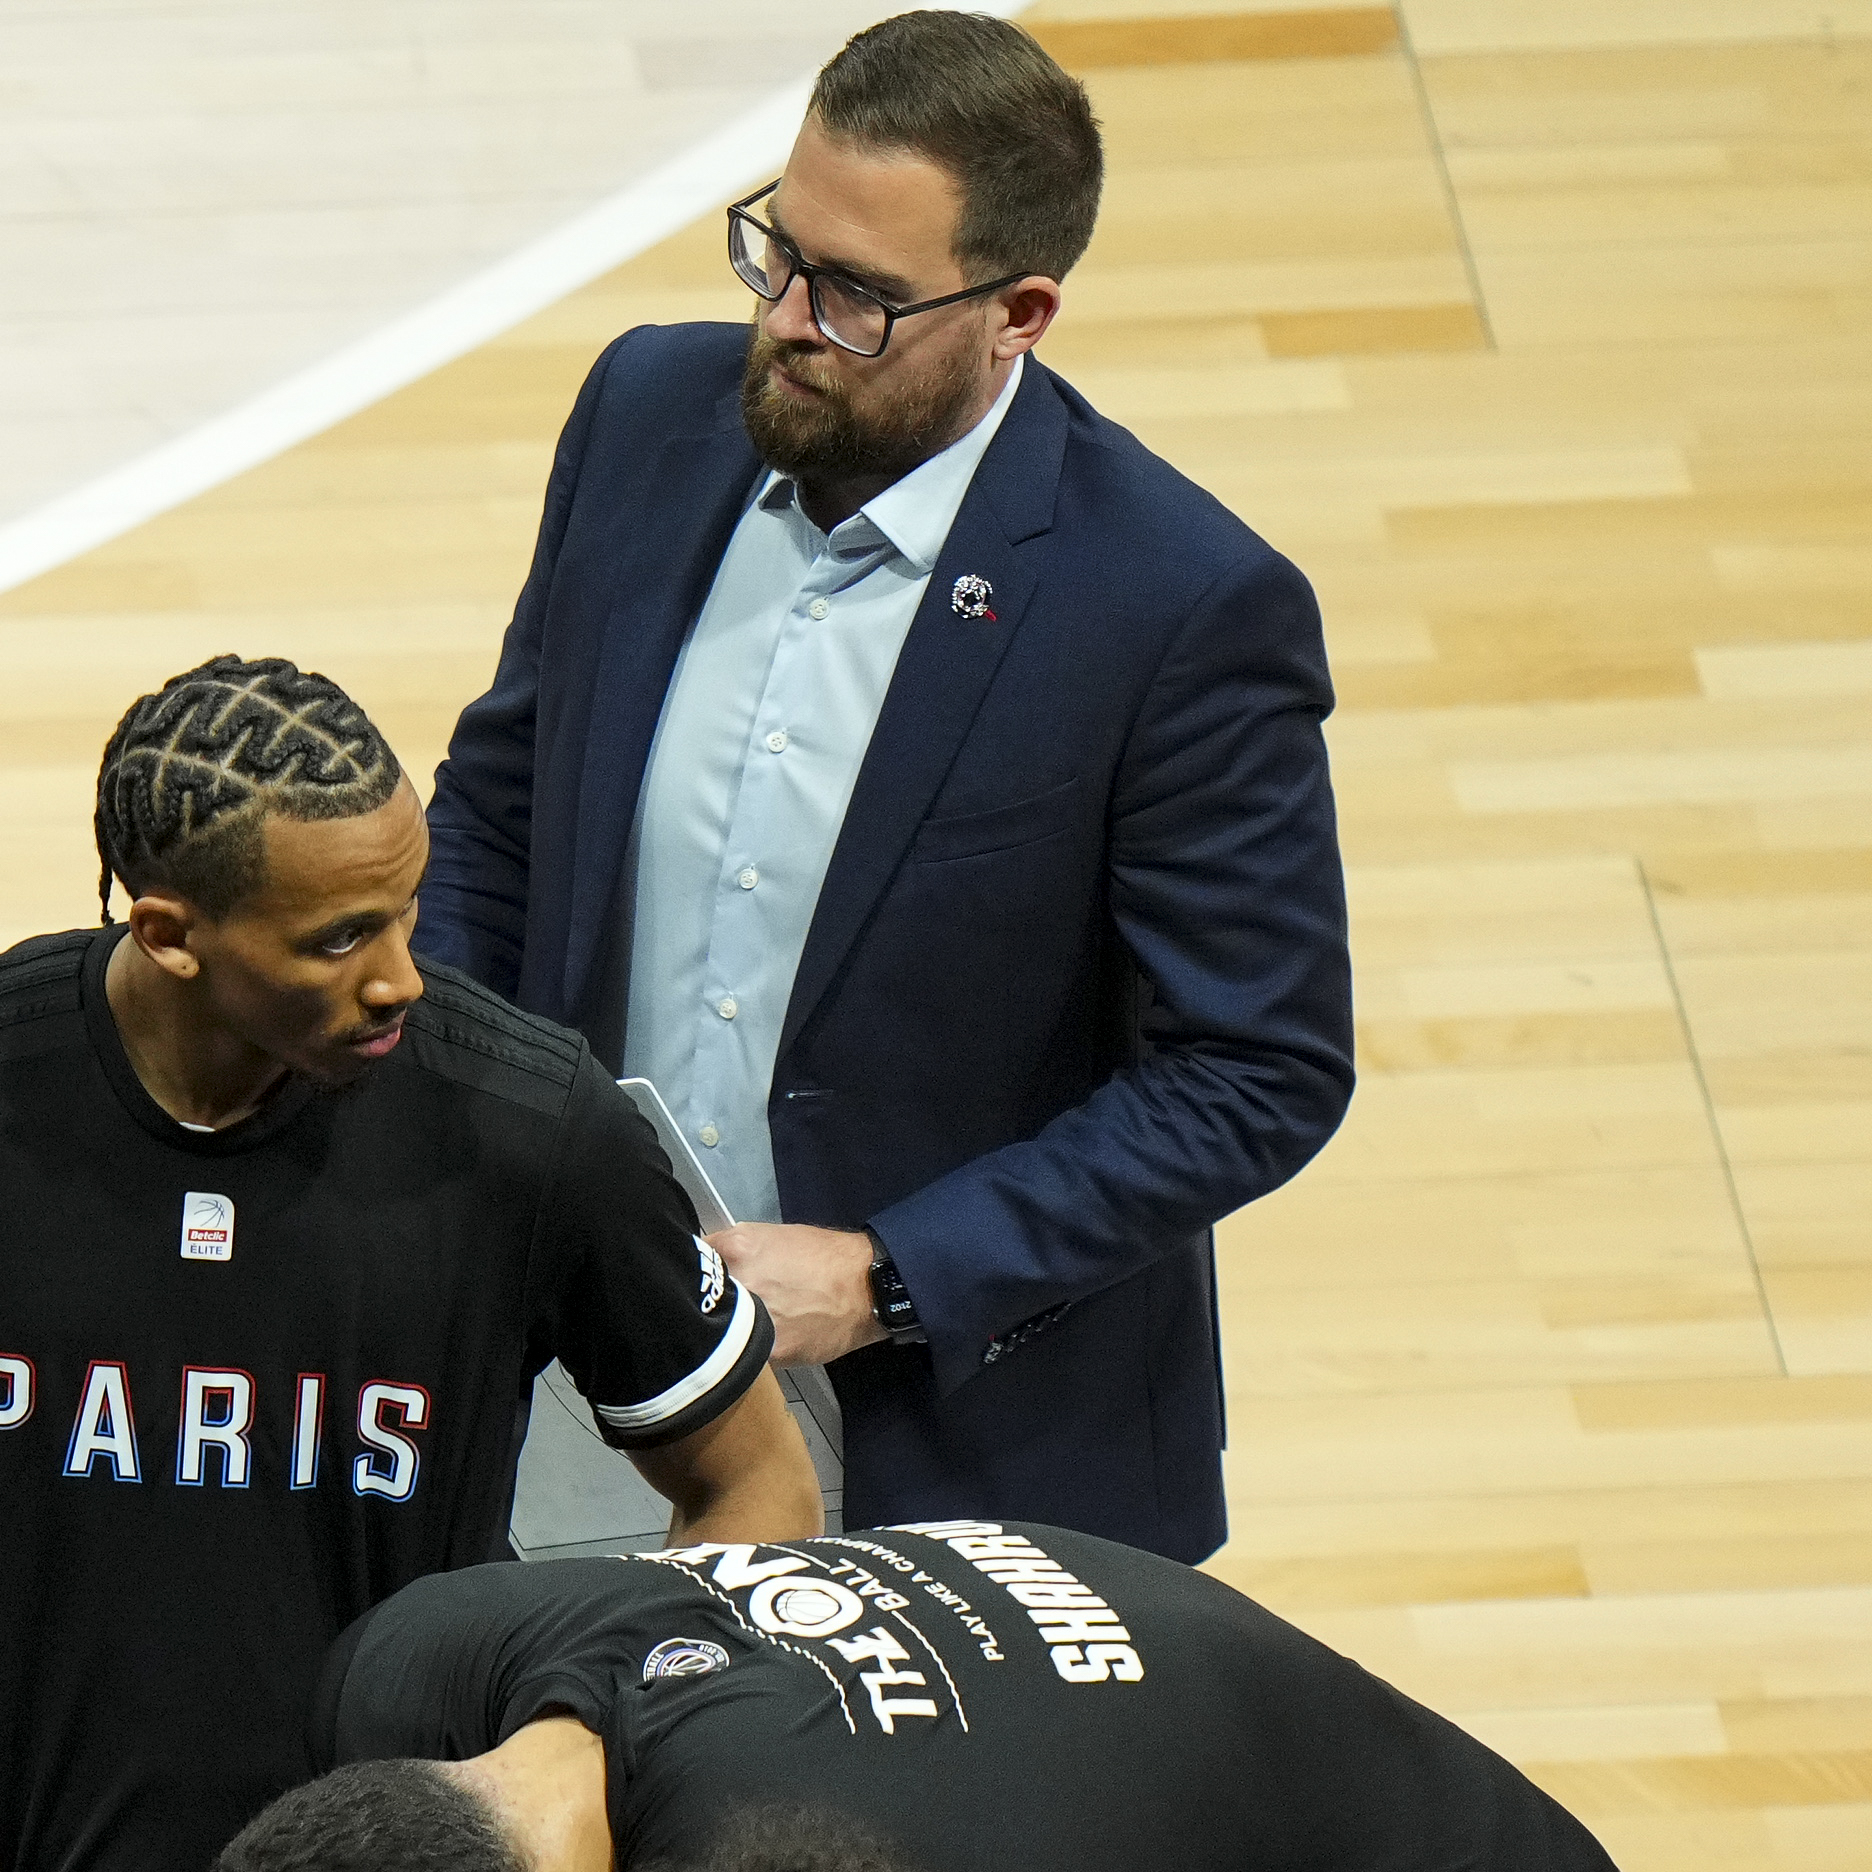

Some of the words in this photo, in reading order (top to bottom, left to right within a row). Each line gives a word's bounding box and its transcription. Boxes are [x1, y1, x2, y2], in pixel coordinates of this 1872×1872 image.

[190, 1231, 225, 1241] Betclic
[829, 1558, 910, 1611] BALL
[912, 1571, 933, 1582] A
[924, 1582, 971, 1613] LIKE
[960, 1615, 1004, 1661] PLAY
[825, 1626, 938, 1735] THE
